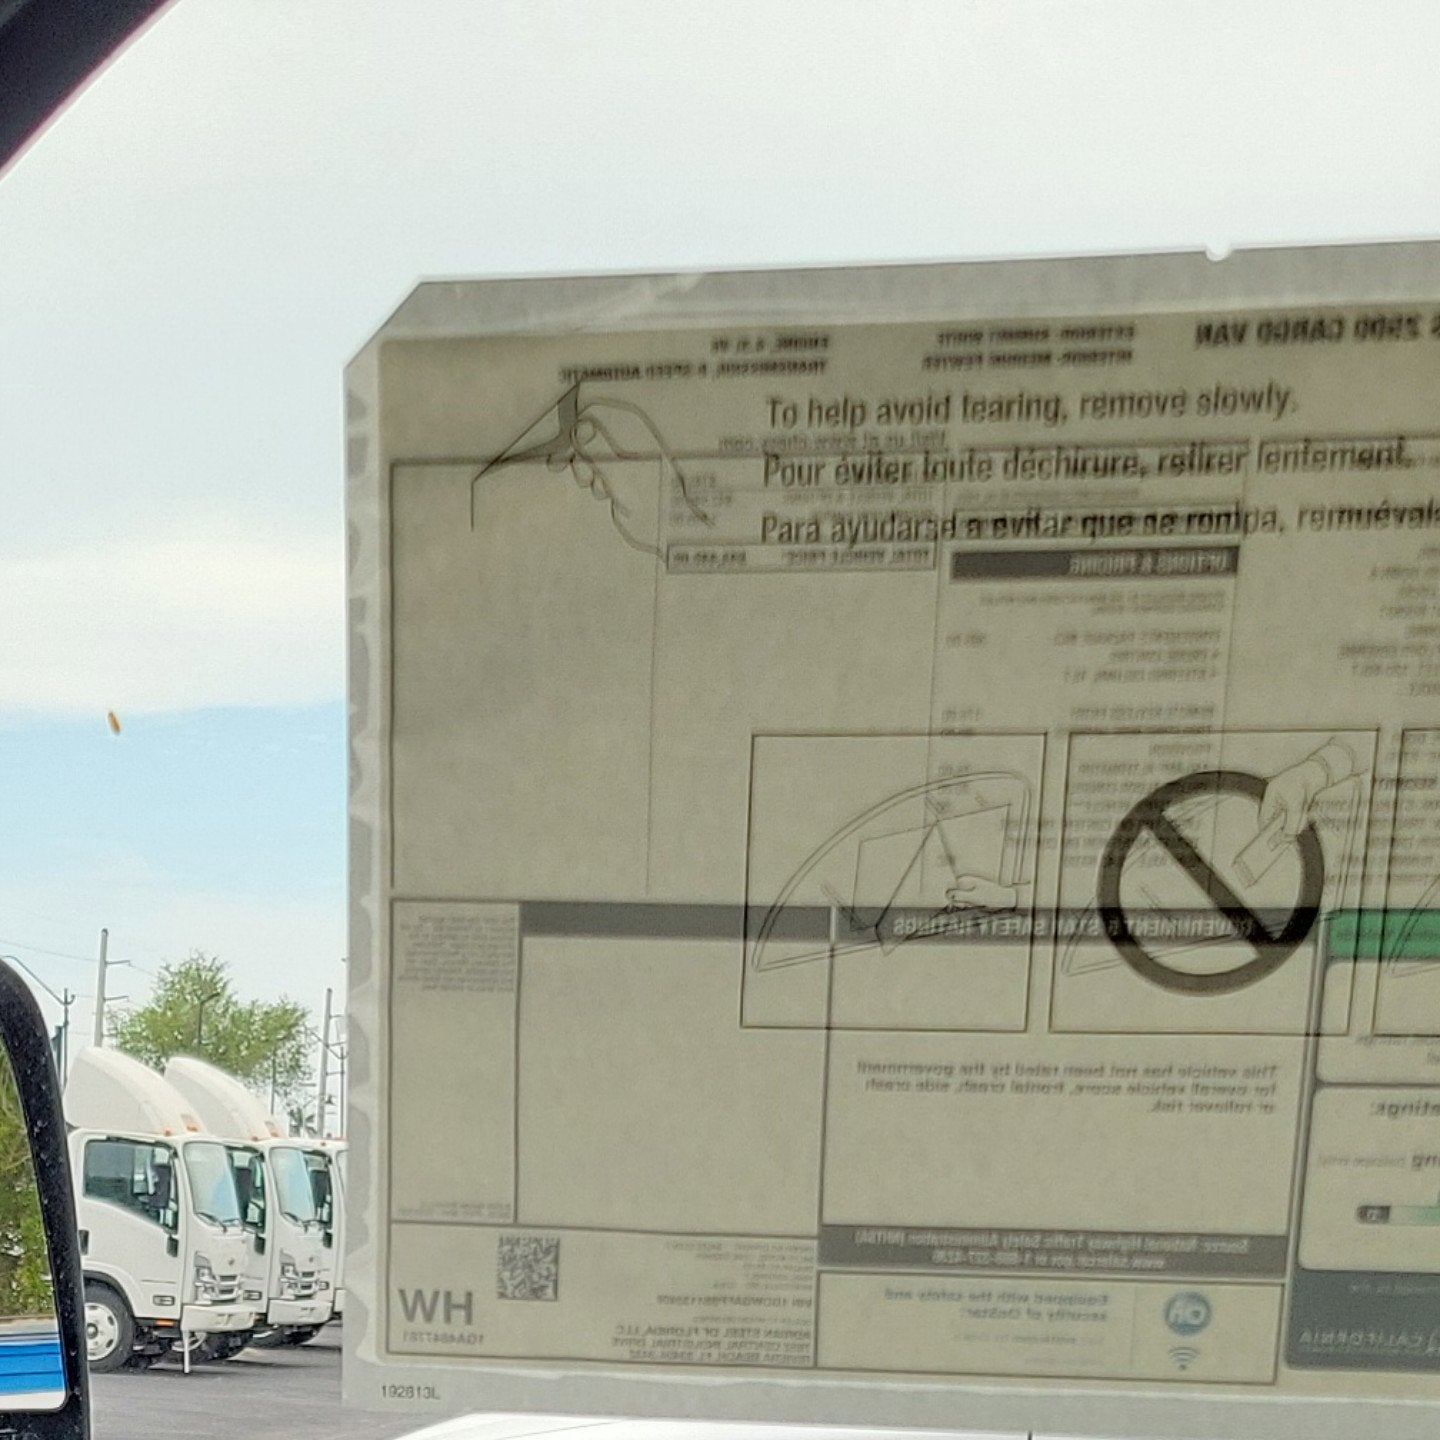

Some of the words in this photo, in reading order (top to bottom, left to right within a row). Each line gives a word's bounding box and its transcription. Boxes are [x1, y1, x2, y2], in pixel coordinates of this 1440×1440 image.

[769, 399, 798, 429] To
[807, 397, 866, 431] help
[876, 394, 951, 425] avoid
[1079, 390, 1186, 420] remove
[764, 454, 822, 488] Pour
[834, 450, 913, 486] éviter
[760, 514, 821, 544] Para
